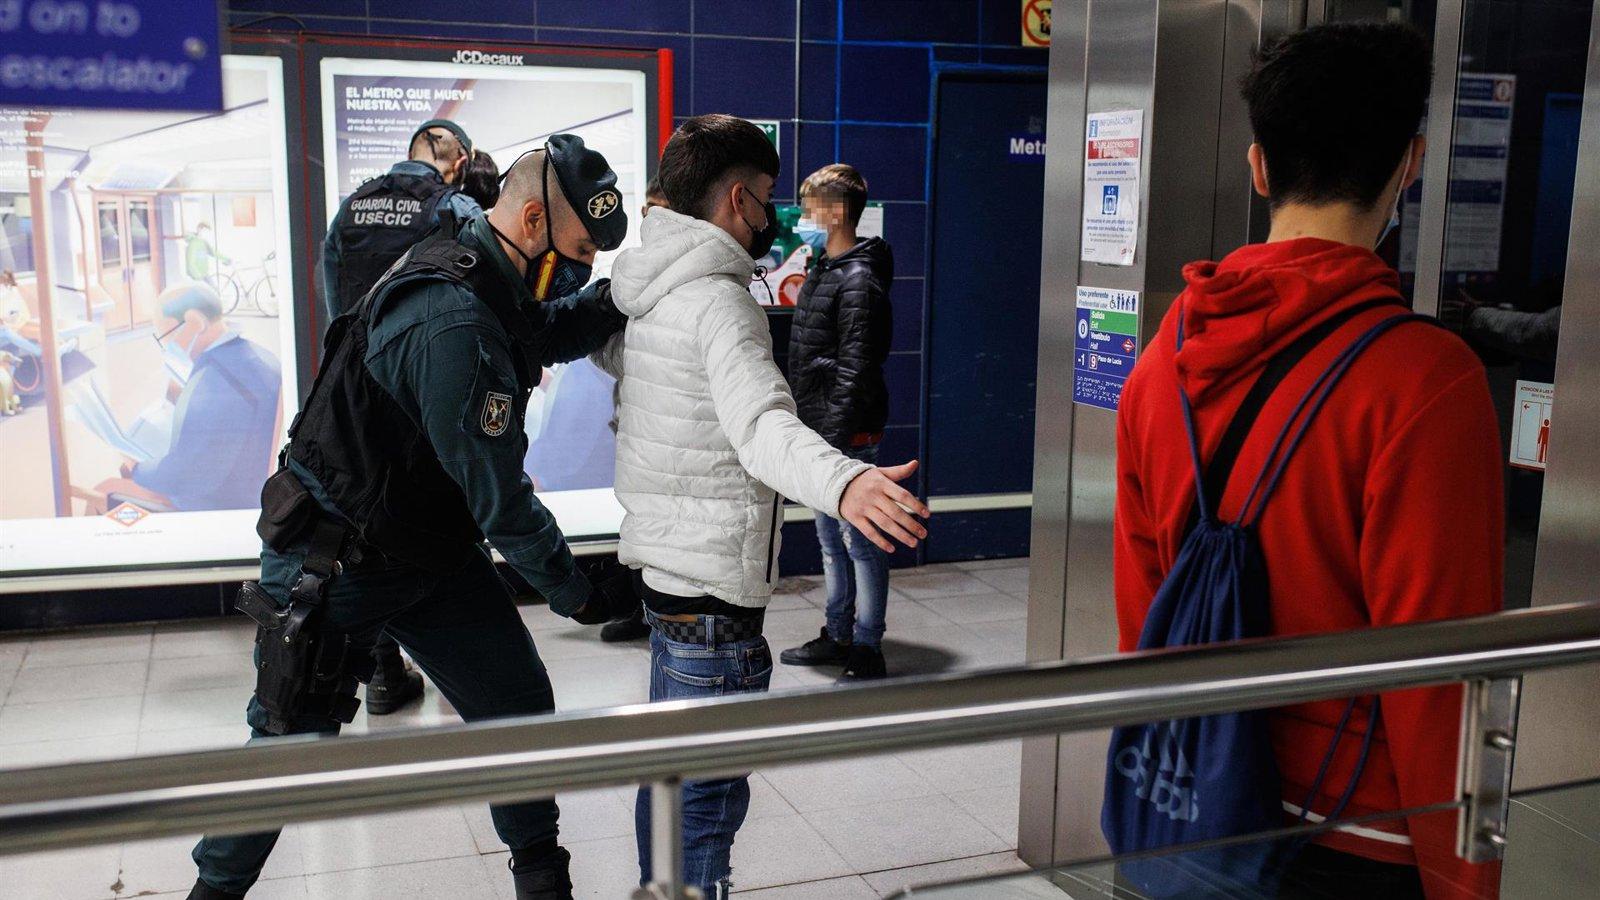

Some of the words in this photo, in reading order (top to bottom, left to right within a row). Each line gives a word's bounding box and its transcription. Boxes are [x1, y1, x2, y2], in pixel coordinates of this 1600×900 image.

[452, 50, 524, 66] JCDecaux
[345, 87, 361, 99] EL
[362, 88, 404, 100] METRO
[406, 90, 432, 100] QUE
[434, 90, 475, 101] MUEVE
[346, 99, 402, 111] NUESTRA
[404, 101, 432, 112] VIDA
[395, 200, 422, 213] CIVIL
[354, 211, 413, 226] USECIC
[1091, 311, 1105, 320] Salida
[1090, 342, 1099, 350] Hall
